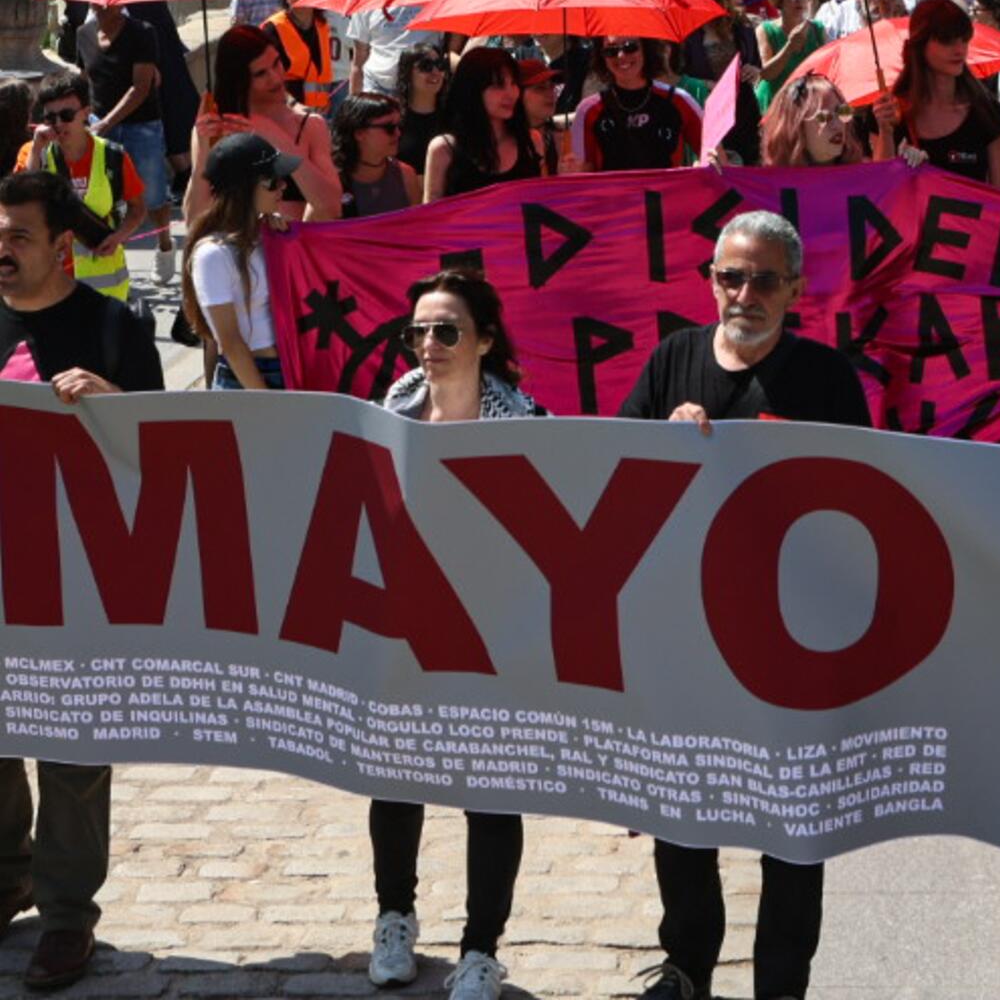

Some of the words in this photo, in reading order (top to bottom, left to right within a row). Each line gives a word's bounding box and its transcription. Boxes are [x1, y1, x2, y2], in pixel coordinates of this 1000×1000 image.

[0, 409, 954, 711] MAYO
[5, 657, 74, 672] MCLMEX
[91, 658, 125, 672] CNT
[132, 658, 224, 676] COMARCAL
[229, 664, 260, 679] SUR
[274, 671, 303, 687] CNT
[308, 679, 358, 705] MADRID
[369, 701, 423, 717] COBAS
[438, 705, 510, 722] ESPACIO
[515, 710, 576, 728] COMÚN
[582, 719, 613, 734] 15M
[628, 727, 646, 742] LA
[651, 732, 770, 761] LABORATORIA
[787, 744, 826, 760] LIZA
[840, 726, 947, 750] MOVIMIENTO
[5, 706, 93, 724] SINDICATO
[100, 710, 124, 723] DE
[130, 710, 227, 726] INQUILINAS
[246, 716, 324, 743] SINDICATO
[329, 734, 346, 750] DE
[351, 743, 435, 769] MANTEROS
[442, 758, 464, 771] DE
[471, 758, 538, 774] MADRID
[557, 764, 641, 791] SINDICATO
[646, 783, 702, 804] OTRAS
[722, 791, 820, 818] SINTRAHOC
[837, 780, 945, 810] SOLIDARIDAD
[6, 674, 135, 689] OBSERVATORIO
[142, 675, 164, 688] DE
[170, 676, 216, 691] DDHH
[222, 680, 242, 693] EN
[249, 683, 297, 703] SALUD
[303, 693, 355, 722] MENTAL
[367, 717, 442, 735] ORGULLO
[450, 724, 494, 738] LOCO
[501, 727, 569, 744] PRENDE
[584, 735, 688, 767] PLATAFORMA
[695, 753, 772, 779] SINDICAL
[779, 766, 801, 780] DE
[810, 762, 831, 777] LA
[836, 753, 866, 773] EMT
[882, 745, 916, 760] RED
[923, 745, 946, 759] DE
[61, 693, 121, 706] GRUPO
[128, 692, 185, 707] ADELA
[190, 695, 210, 708] DE
[217, 697, 237, 710] LA
[243, 699, 322, 727] ASAMBLEA
[327, 717, 389, 748] POPULAR
[395, 737, 417, 750] DE
[423, 739, 555, 761] CARABANCHEL,
[561, 749, 592, 764] RAL
[598, 753, 608, 766] Y
[614, 757, 698, 785] SINDICATO
[707, 772, 742, 788] SAN
[748, 766, 892, 799] BLAS-CANILLEJAS
[909, 762, 945, 775] RED
[6, 722, 79, 740] RACISMO
[93, 727, 161, 740] MADRID
[193, 729, 237, 744] STEM
[268, 736, 334, 764] TABADOL
[356, 761, 453, 786] TERRITORIO
[466, 775, 567, 794] DOMÉSTICO
[597, 786, 649, 811] TRANS
[660, 804, 682, 820] EN
[696, 807, 756, 826] LUCHA
[784, 810, 862, 837] VALIENTE
[874, 797, 944, 818] BANGLA
